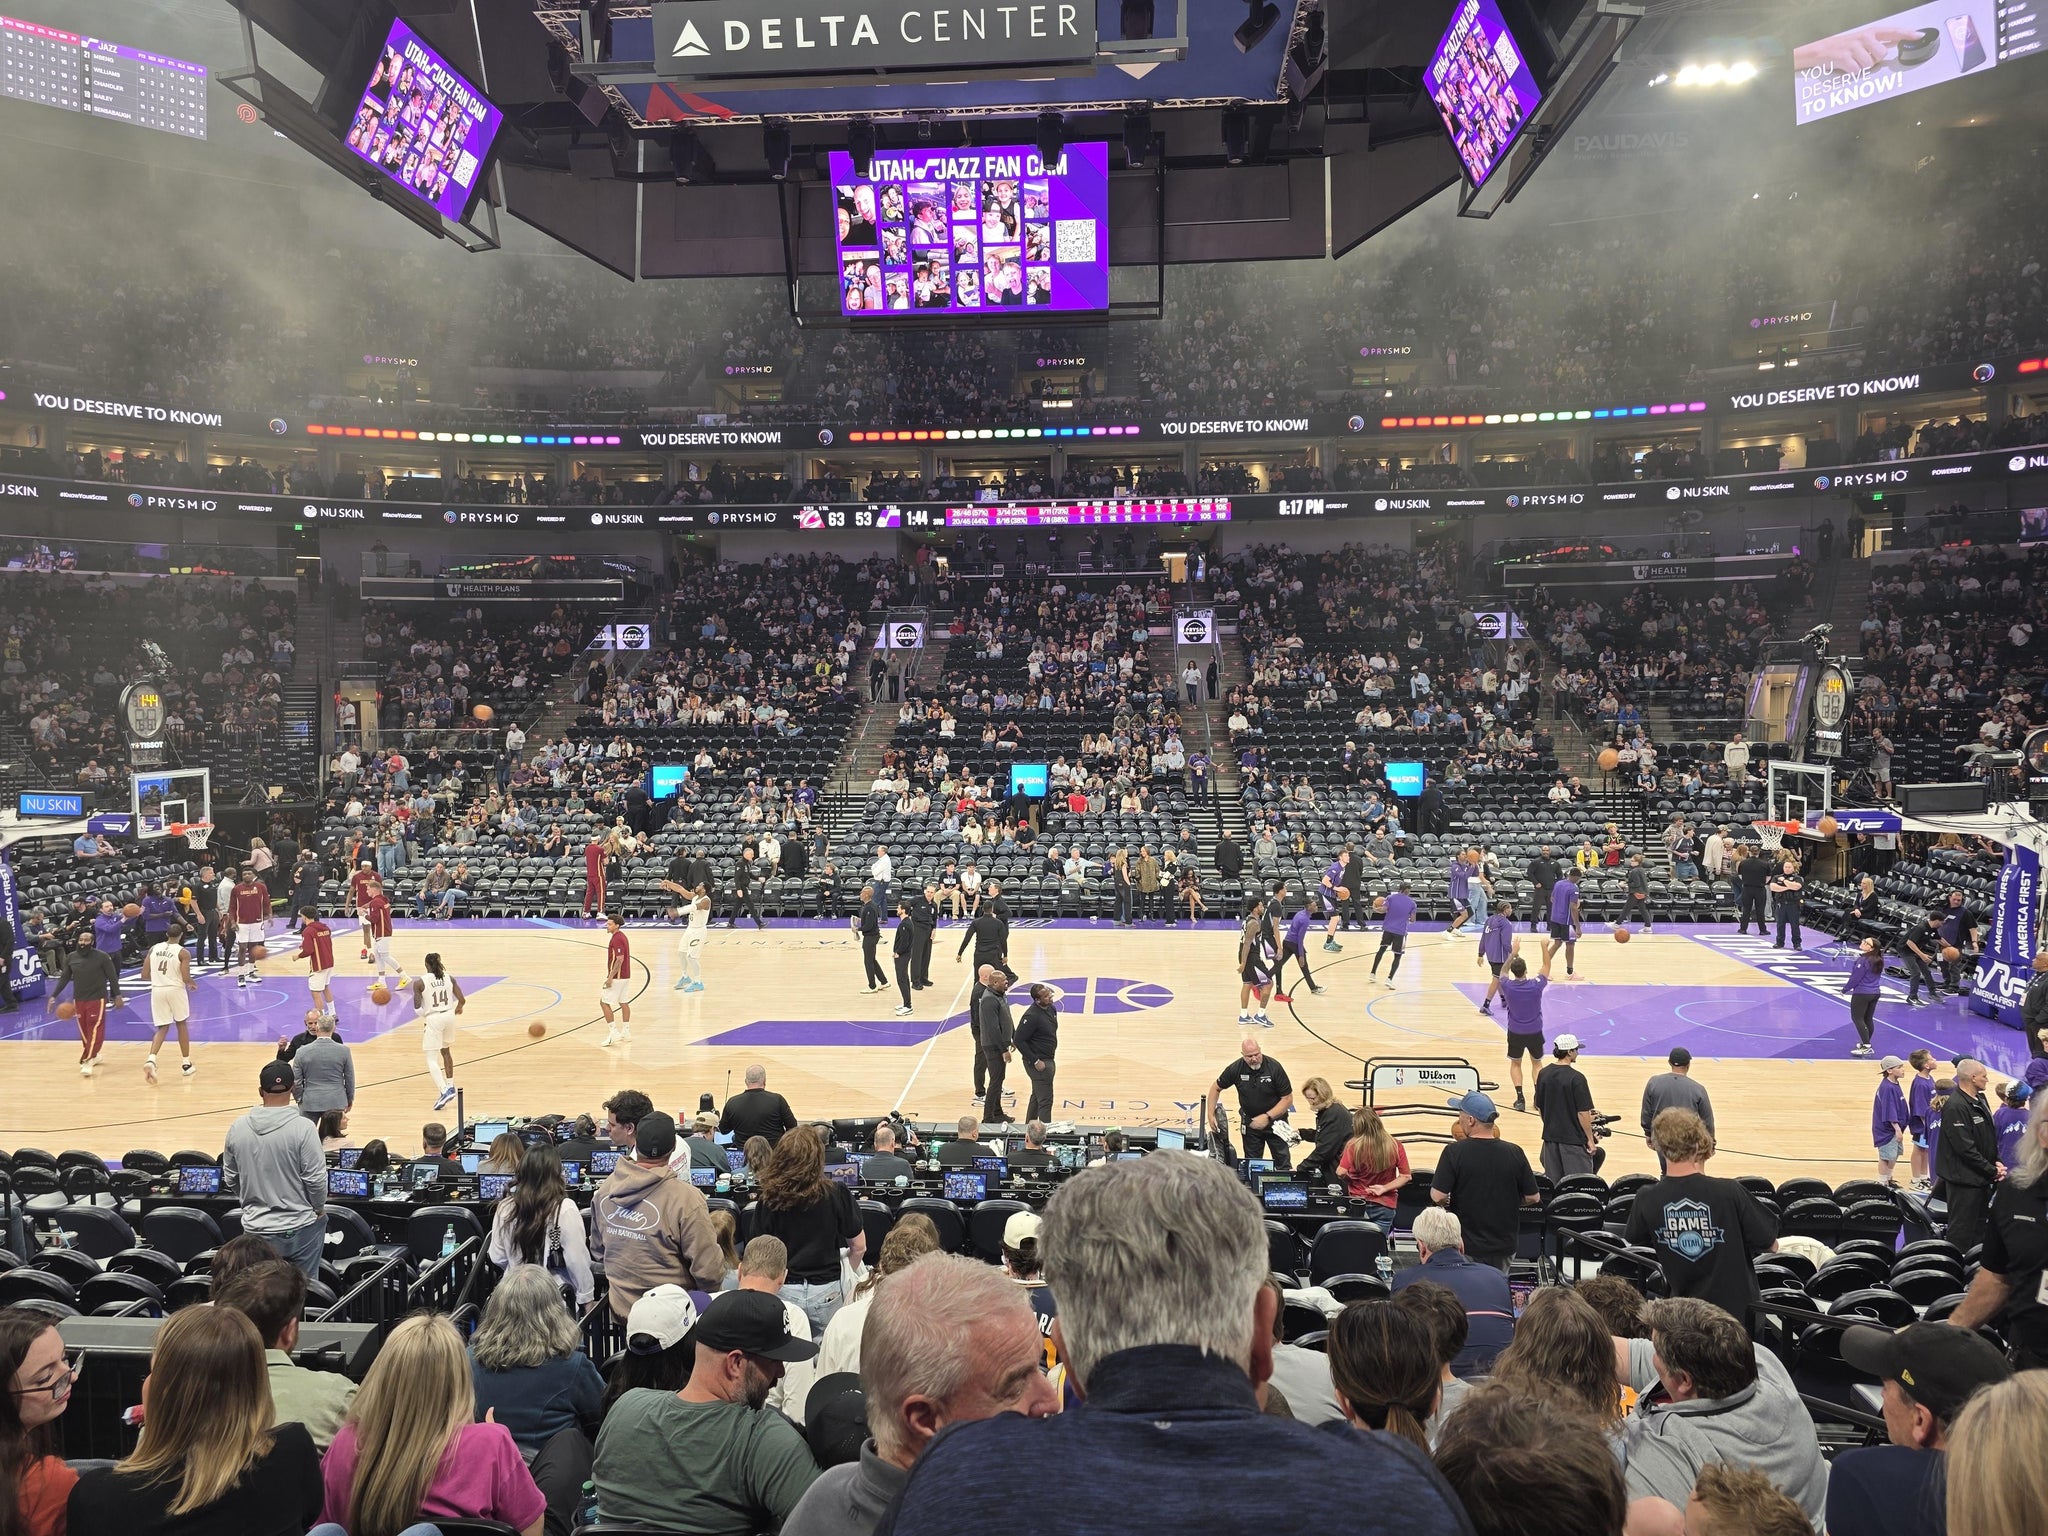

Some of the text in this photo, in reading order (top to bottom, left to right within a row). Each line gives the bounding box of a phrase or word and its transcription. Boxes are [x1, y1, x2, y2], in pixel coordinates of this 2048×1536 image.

[723, 4, 1078, 51] DELTA CENTER
[98, 43, 118, 54] JAZZ
[94, 67, 120, 77] WILLIAMS
[1800, 60, 1834, 82] YOU
[404, 40, 488, 122] UTAH JAZZ FAN CAM
[1802, 66, 1871, 100] DESERVE
[1802, 71, 1903, 116] TO KNOW!
[869, 154, 1067, 181] UTAH JAZZ FAN CAM
[1763, 314, 1798, 325] PRYSM
[375, 356, 406, 365] PRYSM
[1731, 374, 1920, 408] YOU DESERVE TO KNOW!
[34, 393, 222, 426] YOU DESERVE TO KNOW!
[1160, 419, 1308, 434] YOU DESERVE TO KNOW!
[641, 432, 781, 445] YOU DESERVE TO KNOW!
[2030, 456, 2048, 468] NU
[1932, 467, 1962, 476] POWERED
[1834, 474, 1886, 487] PRYSM
[1683, 487, 1701, 497] NU
[148, 497, 197, 510] PRYSM
[1390, 500, 1405, 509] NU
[1523, 495, 1567, 505] PRYSM
[320, 508, 337, 518] NU
[1279, 499, 1324, 515] 8:17 PM
[460, 513, 502, 523] PRYSM
[605, 515, 620, 523] NU
[723, 513, 762, 522] PRYSM
[828, 512, 844, 526] 63
[855, 512, 872, 526] 53
[907, 510, 928, 525] 1:44
[1651, 566, 1686, 575] HEALTH
[1828, 678, 1842, 693] 1:44
[141, 694, 158, 707] 1:44
[26, 799, 45, 810] NU
[0, 868, 12, 896] FIRST
[1994, 867, 2012, 954] AMERICA FIRST
[2018, 870, 2032, 960] AMERICA FIRST
[1692, 934, 1824, 964] UTAH
[157, 960, 168, 975] 4
[22, 973, 42, 984] FIRST
[432, 990, 449, 1007] 14
[1972, 987, 2017, 1008] AMERICA FIRST
[1419, 1070, 1456, 1079] Wilson
[970, 1098, 1148, 1111] CENER
[1668, 1218, 1709, 1231] GAME
[618, 1229, 646, 1240] BASKETBALL
[1682, 1240, 1700, 1248] UTAH
